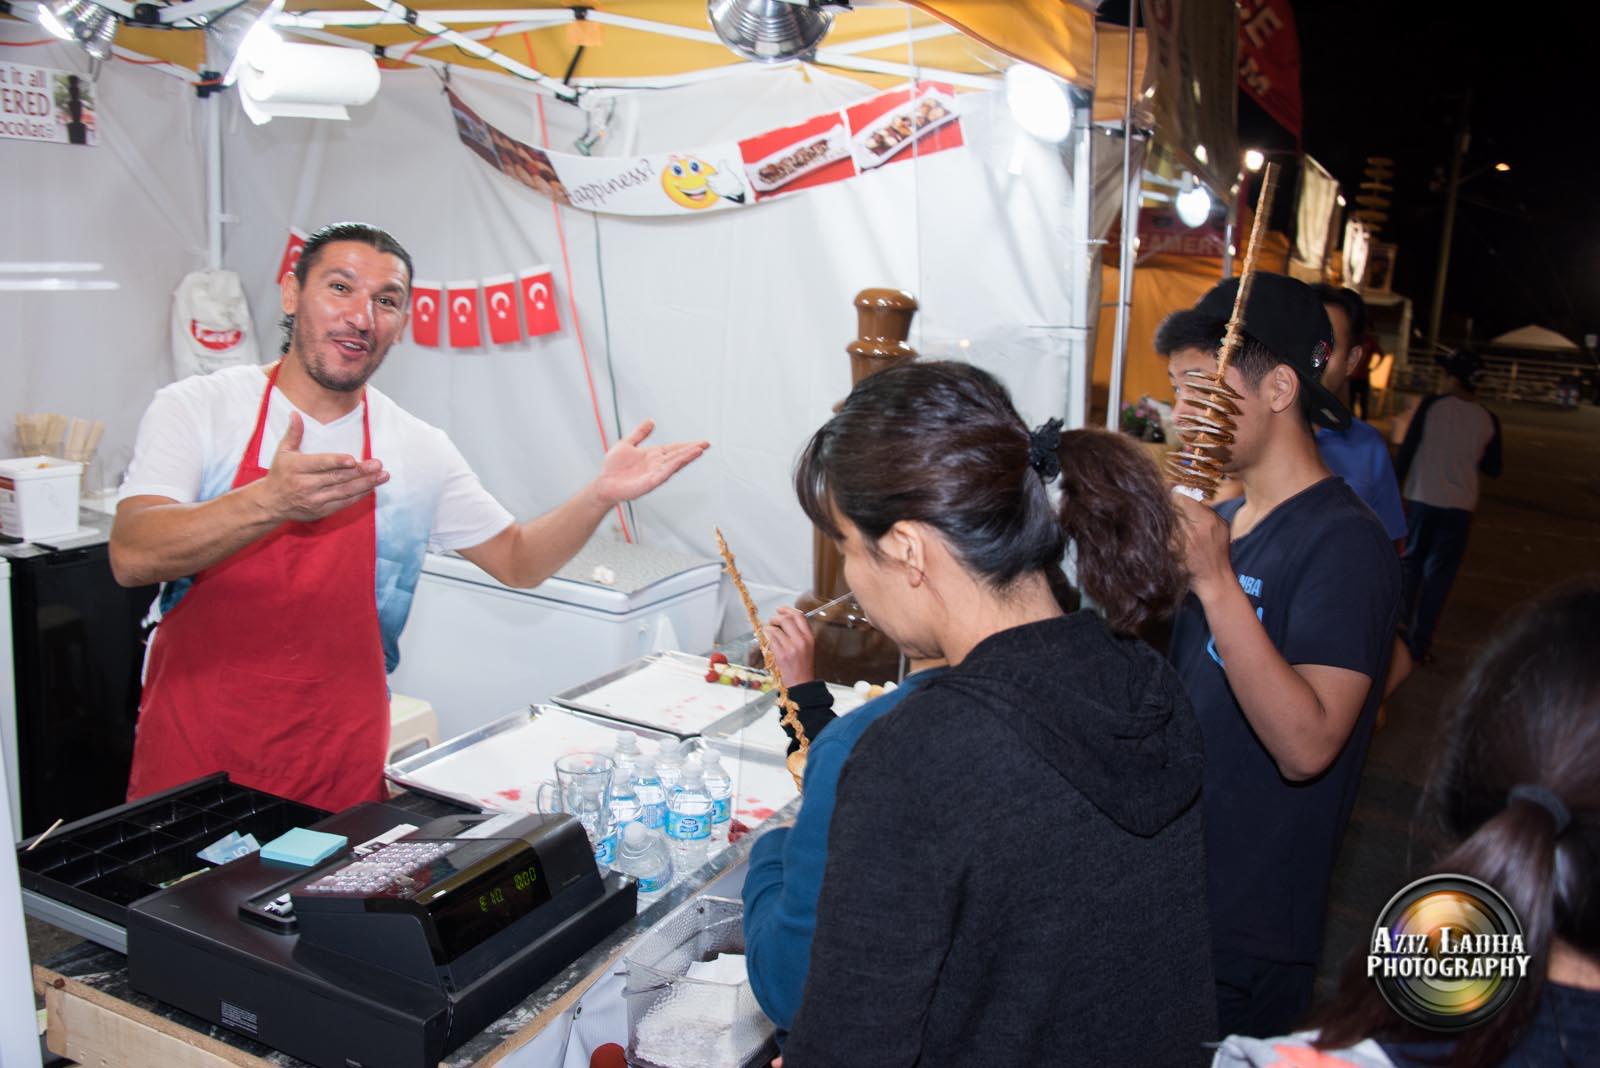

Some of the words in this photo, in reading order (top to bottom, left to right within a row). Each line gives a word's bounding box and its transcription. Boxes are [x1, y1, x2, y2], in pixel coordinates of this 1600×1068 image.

[11, 66, 24, 86] it
[29, 69, 47, 88] all
[1, 87, 51, 117] ERED
